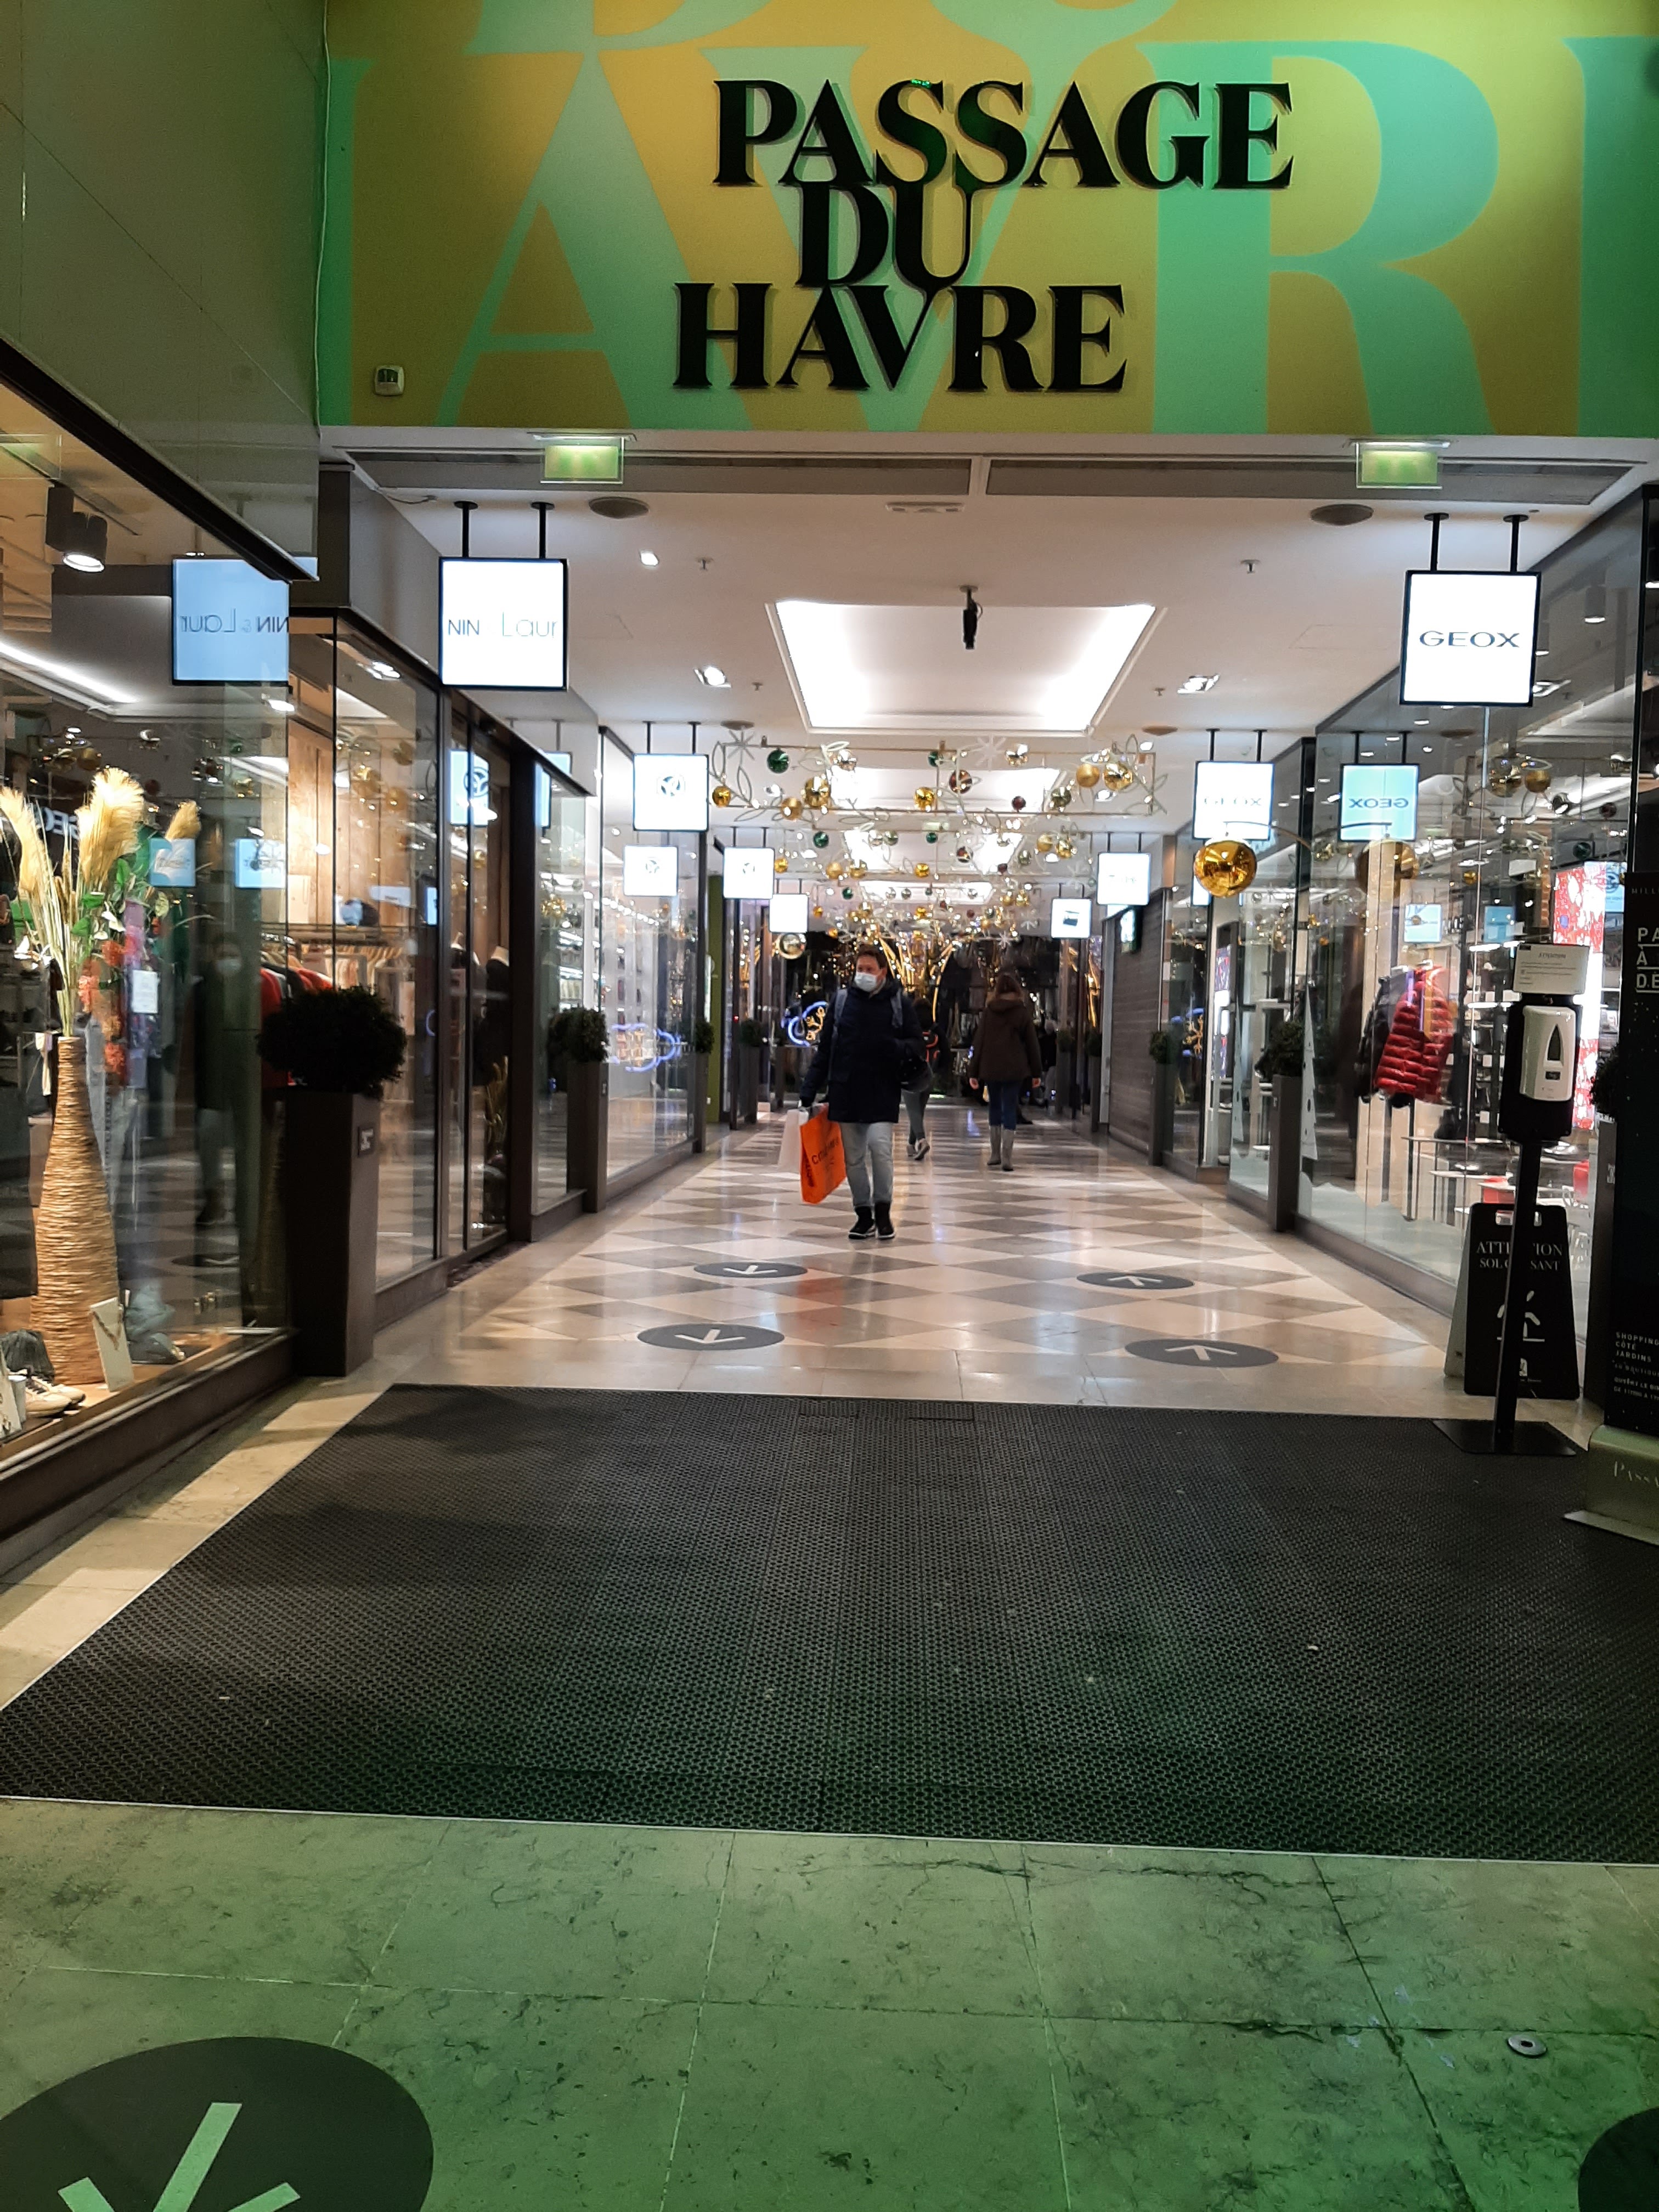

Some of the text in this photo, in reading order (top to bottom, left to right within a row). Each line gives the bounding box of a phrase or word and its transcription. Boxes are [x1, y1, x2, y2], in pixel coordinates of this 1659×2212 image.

[712, 80, 1294, 190] PASSAGE
[794, 183, 980, 289] DU
[673, 282, 1128, 394] HAVRE
[448, 619, 479, 636] NIN
[1419, 630, 1520, 648] GEOX
[1477, 1241, 1562, 1256] ATTION
[1480, 1257, 1503, 1269] SOL
[1616, 1351, 1651, 1363] JARDINS
